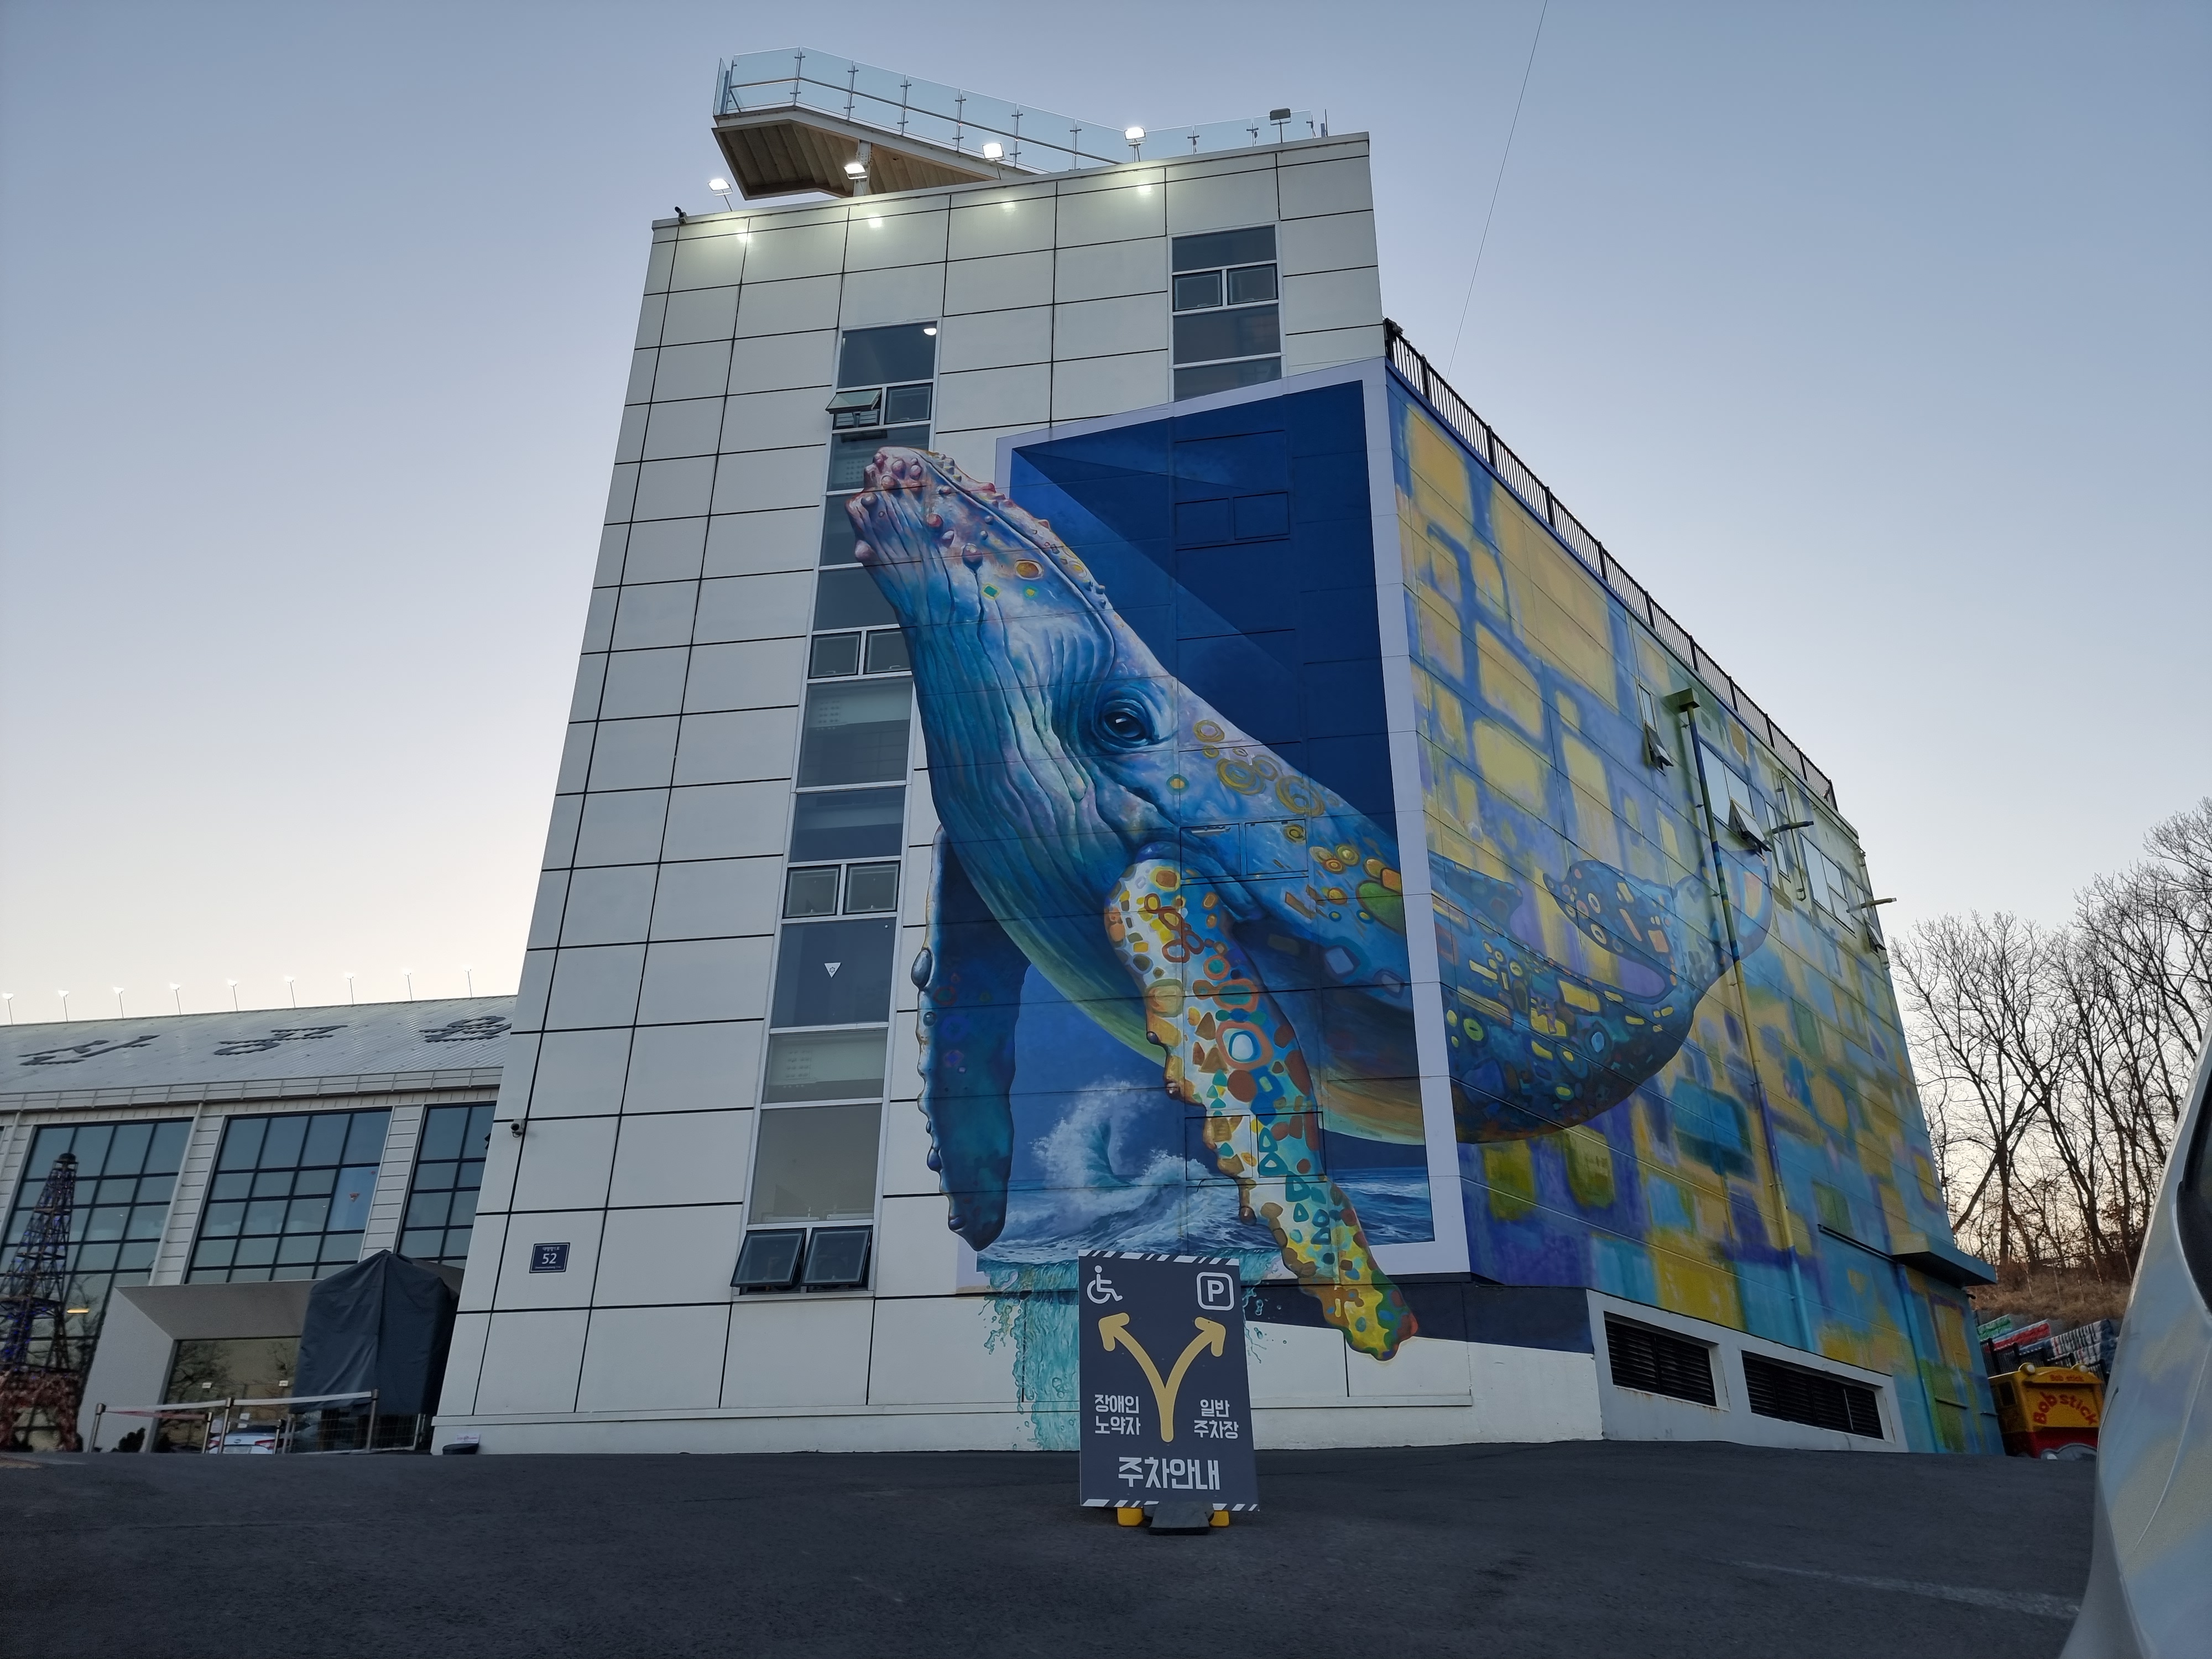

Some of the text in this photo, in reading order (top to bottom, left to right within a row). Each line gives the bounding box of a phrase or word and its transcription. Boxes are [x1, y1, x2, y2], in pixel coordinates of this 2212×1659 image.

[542, 1253, 557, 1264] 52
[1207, 1280, 1224, 1302] P
[1094, 1394, 1140, 1414] 장애인
[1199, 1399, 1230, 1418] 일반
[1095, 1416, 1141, 1436] 노약자
[1193, 1420, 1239, 1439] 주차장
[1118, 1456, 1220, 1490] 주차안내
